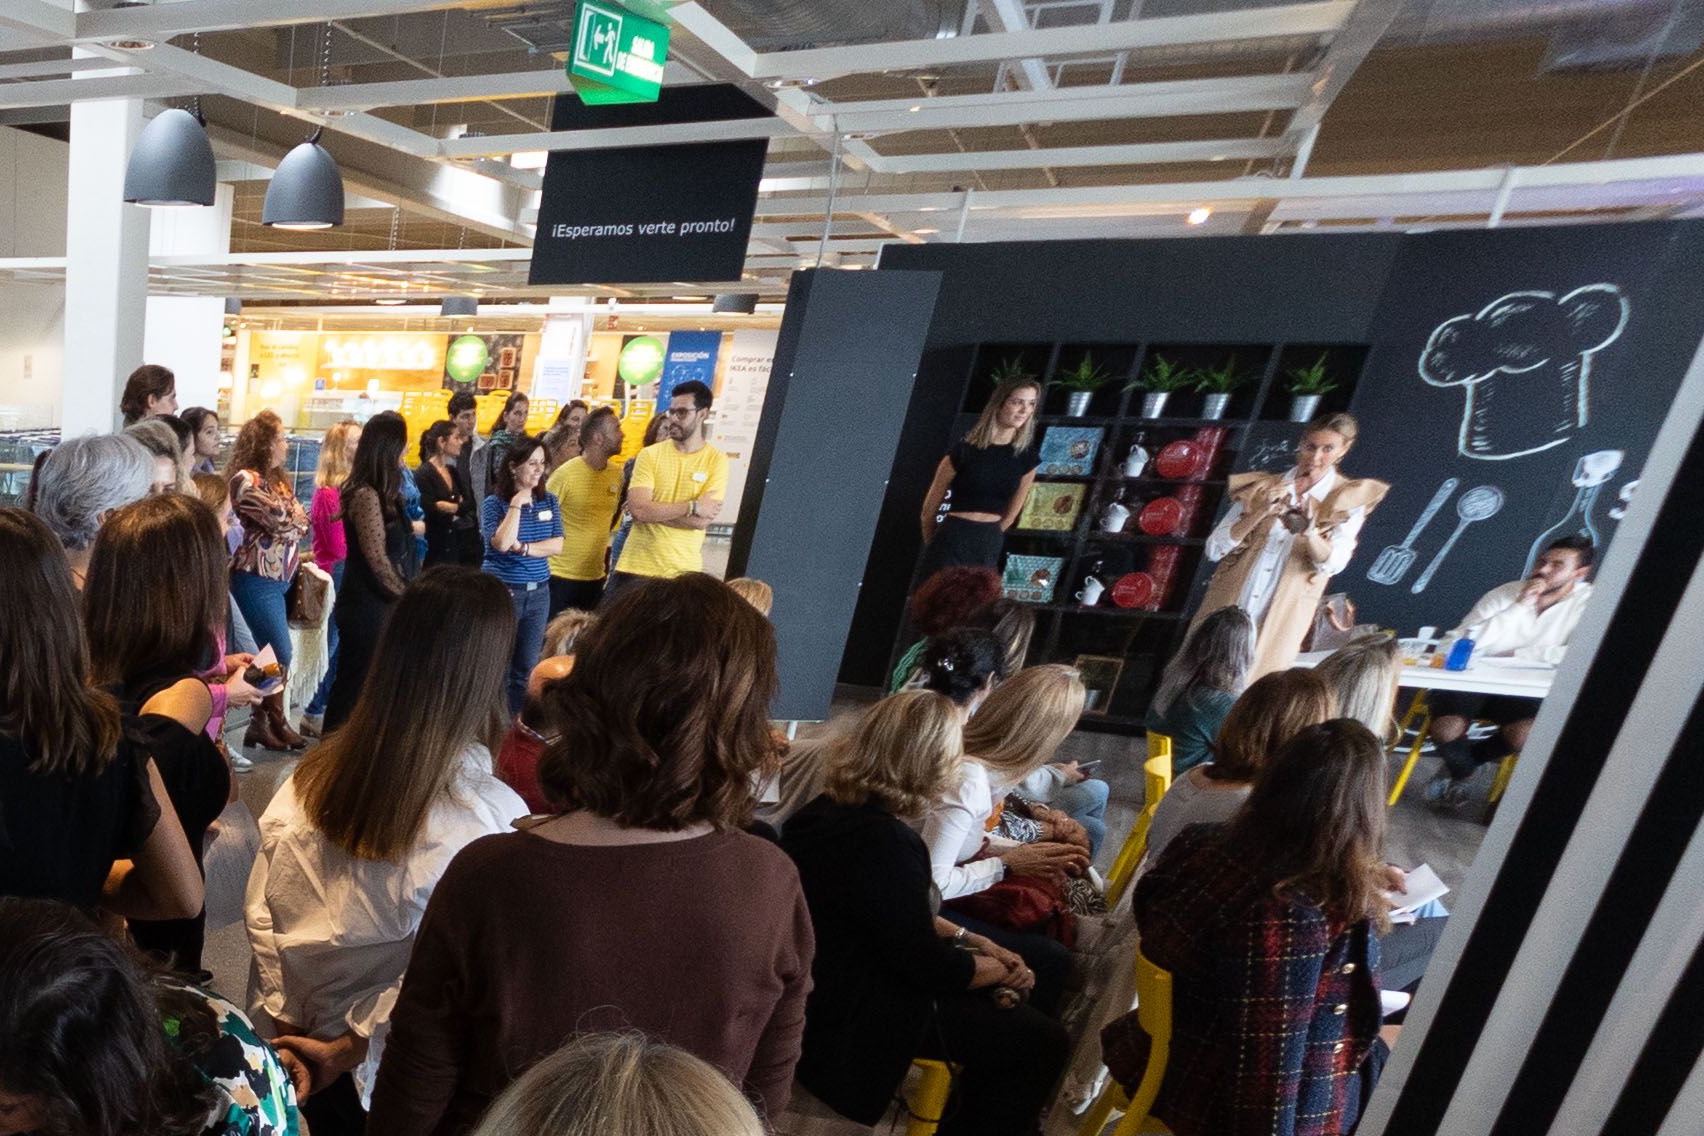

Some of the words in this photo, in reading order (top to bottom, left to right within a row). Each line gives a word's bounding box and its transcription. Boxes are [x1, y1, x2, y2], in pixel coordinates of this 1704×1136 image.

[551, 223, 634, 240] ¡Esperamos
[638, 221, 676, 235] verte
[679, 218, 736, 237] pronto!
